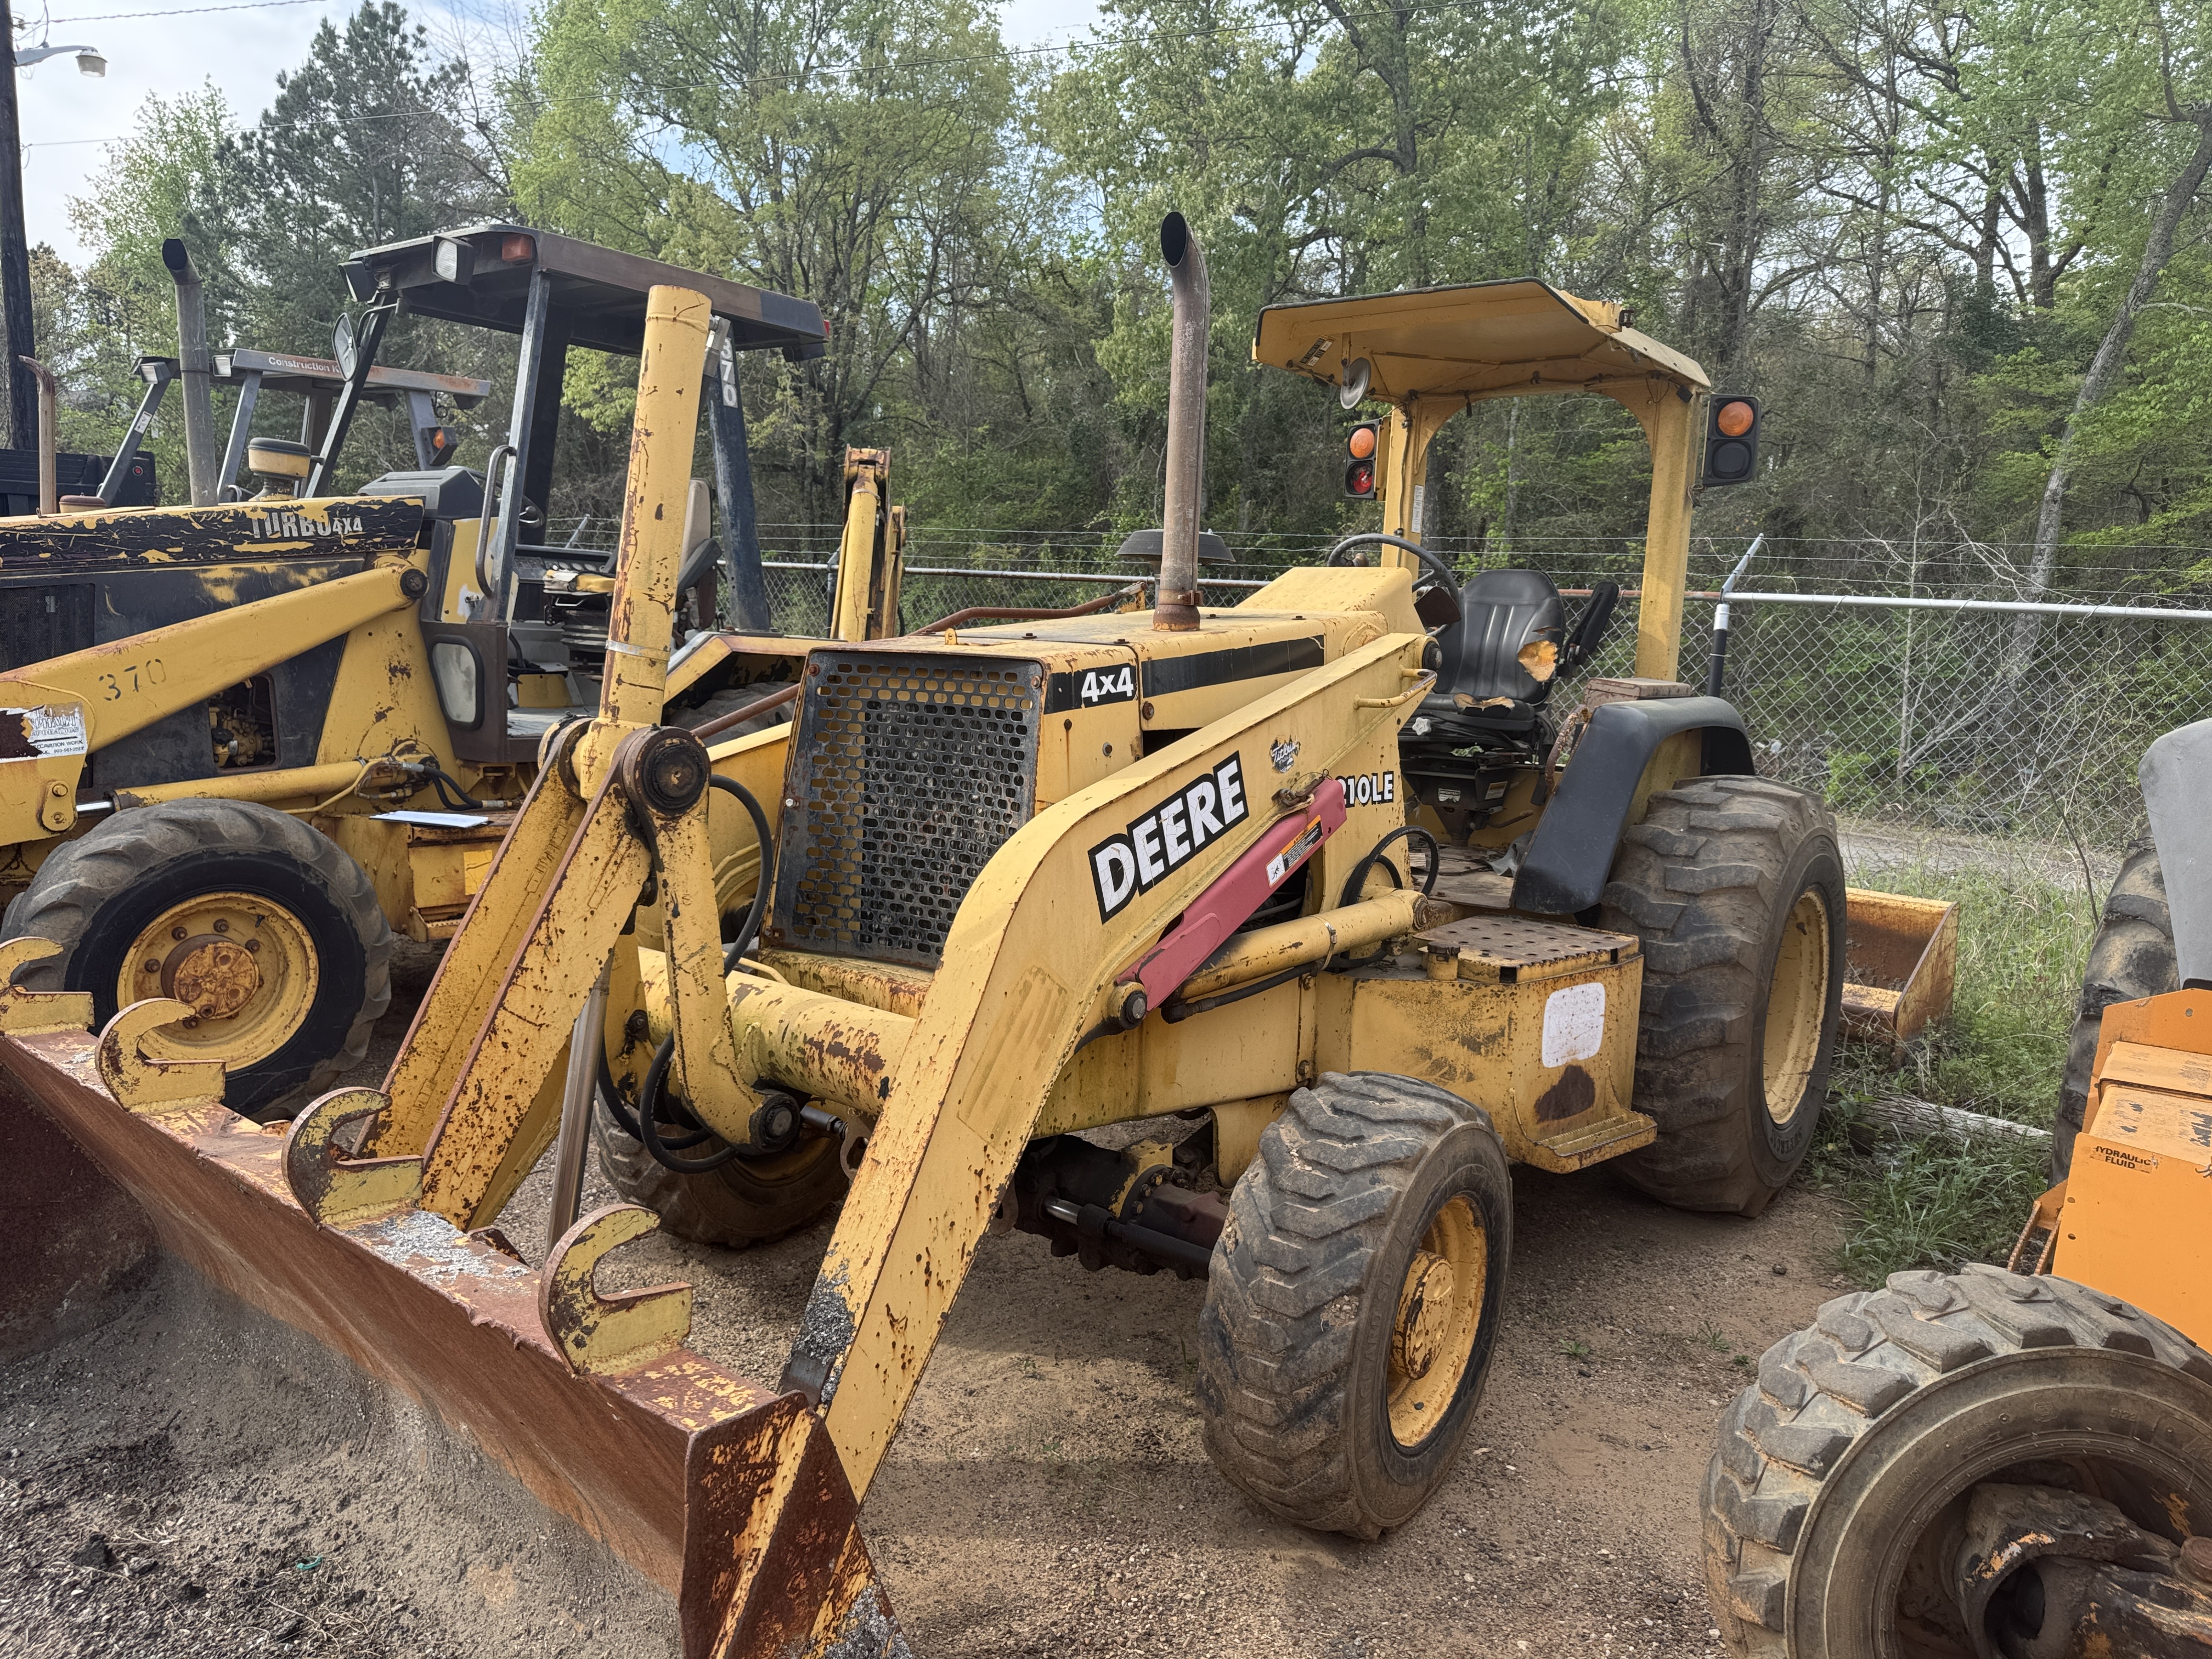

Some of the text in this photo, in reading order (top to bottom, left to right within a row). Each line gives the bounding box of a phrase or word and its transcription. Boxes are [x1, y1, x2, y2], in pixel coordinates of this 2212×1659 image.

[268, 357, 330, 373] Construction
[720, 337, 737, 407] 370
[252, 512, 332, 539] TURBO
[99, 658, 166, 701] 370
[1095, 760, 1245, 913] DEERE
[2092, 1146, 2152, 1166] HYDRAULIC
[2105, 1155, 2136, 1169] FLUID
[1883, 1466, 1923, 1510] NYLON
